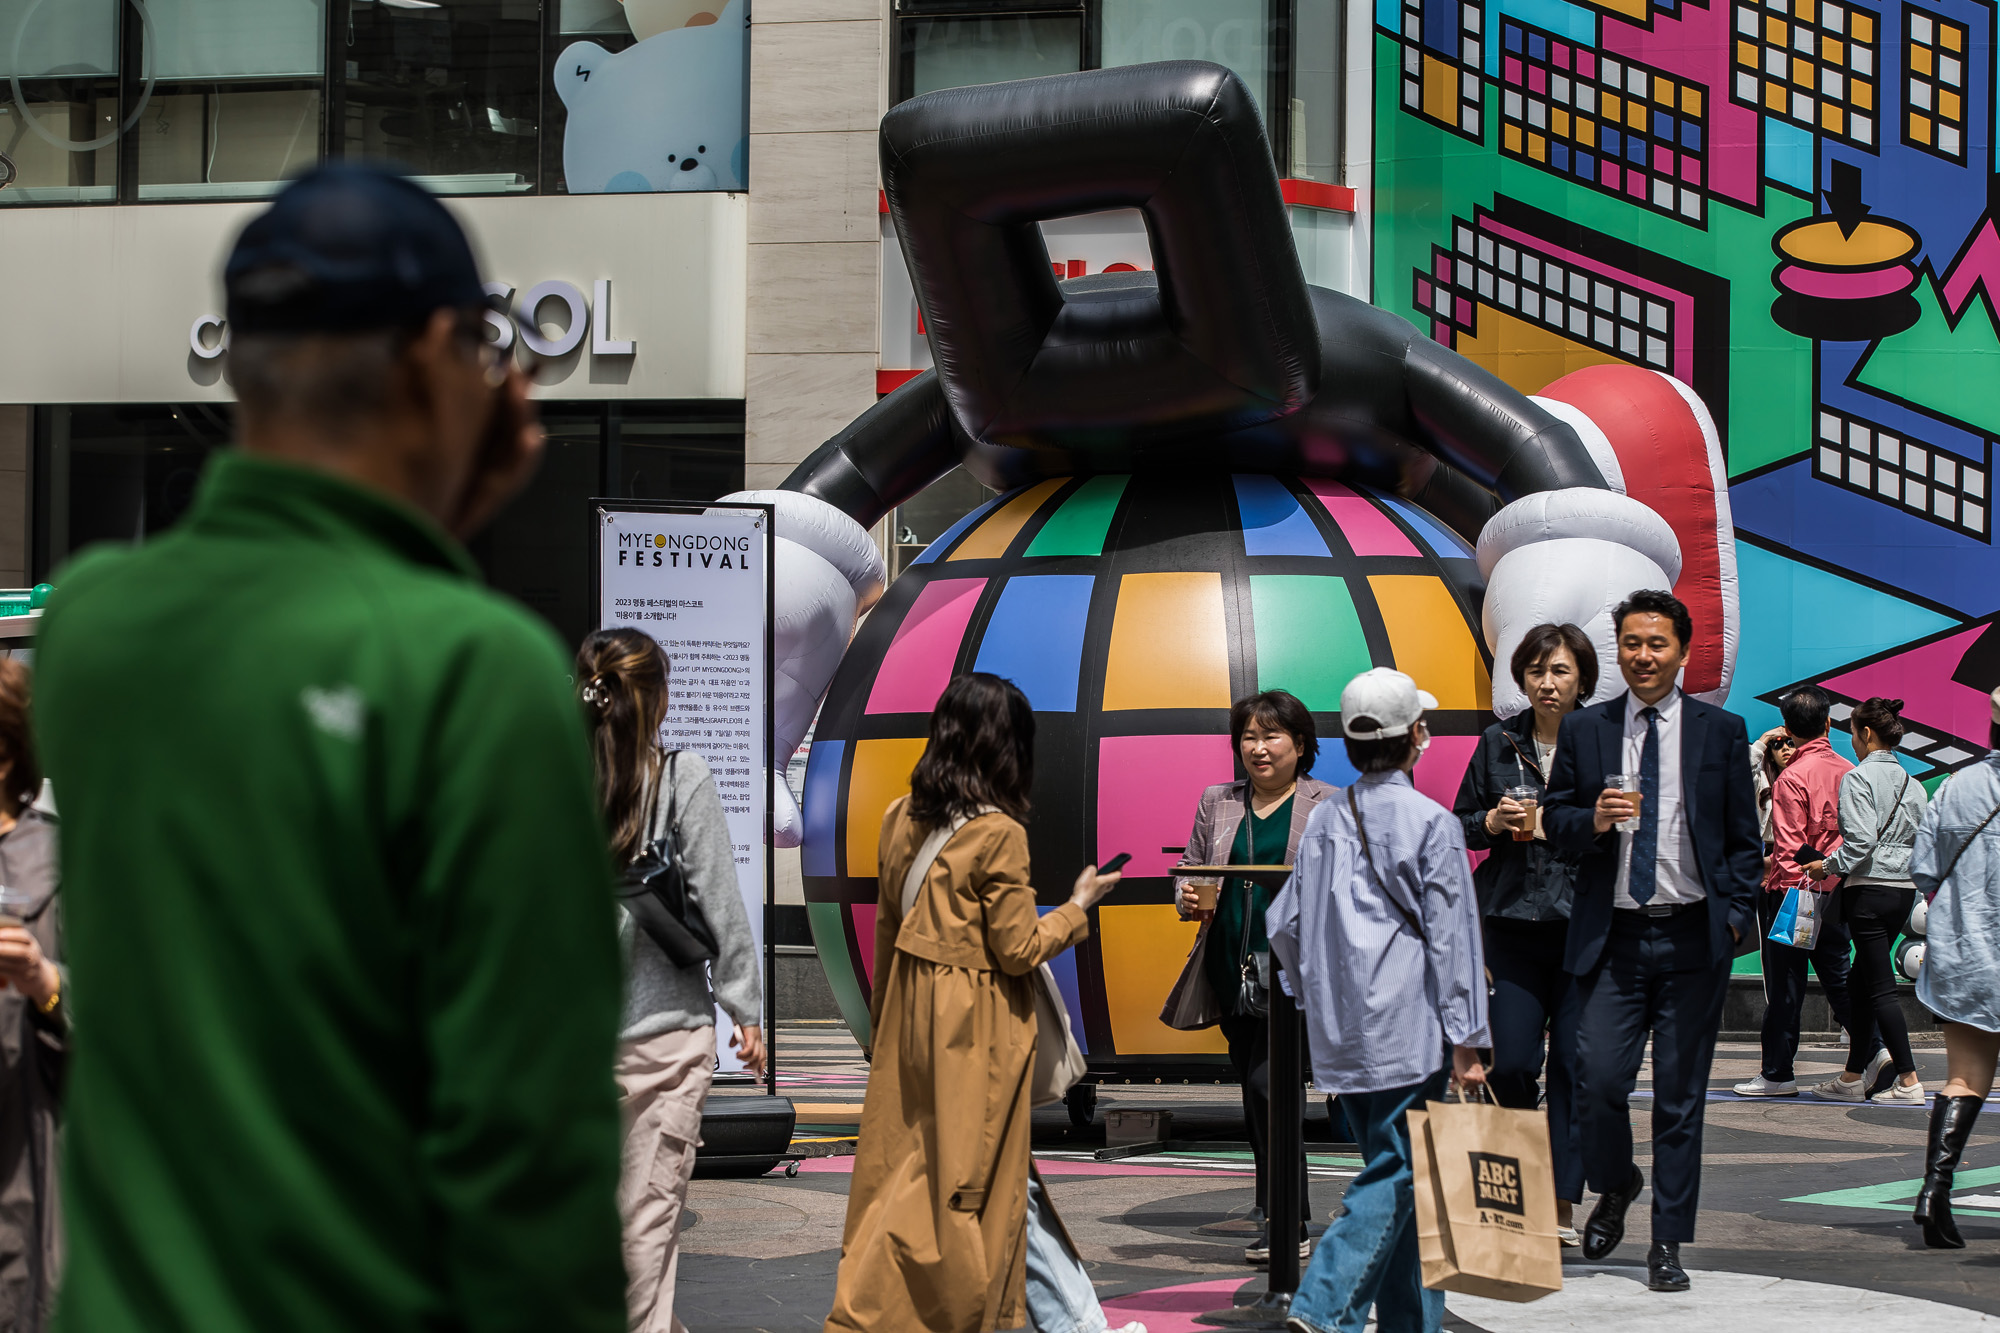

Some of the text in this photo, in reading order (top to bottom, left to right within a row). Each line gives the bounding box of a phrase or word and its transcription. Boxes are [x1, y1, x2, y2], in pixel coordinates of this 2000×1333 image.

[618, 532, 749, 551] MYEONGDONG
[618, 551, 749, 570] FESTIVAL
[632, 598, 646, 607] 명동
[646, 599, 678, 608] 페스티벌의
[678, 600, 704, 608] 마스코트
[644, 612, 676, 620] 소개합니다!
[1478, 1159, 1518, 1188] ABC
[1479, 1183, 1518, 1204] MART
